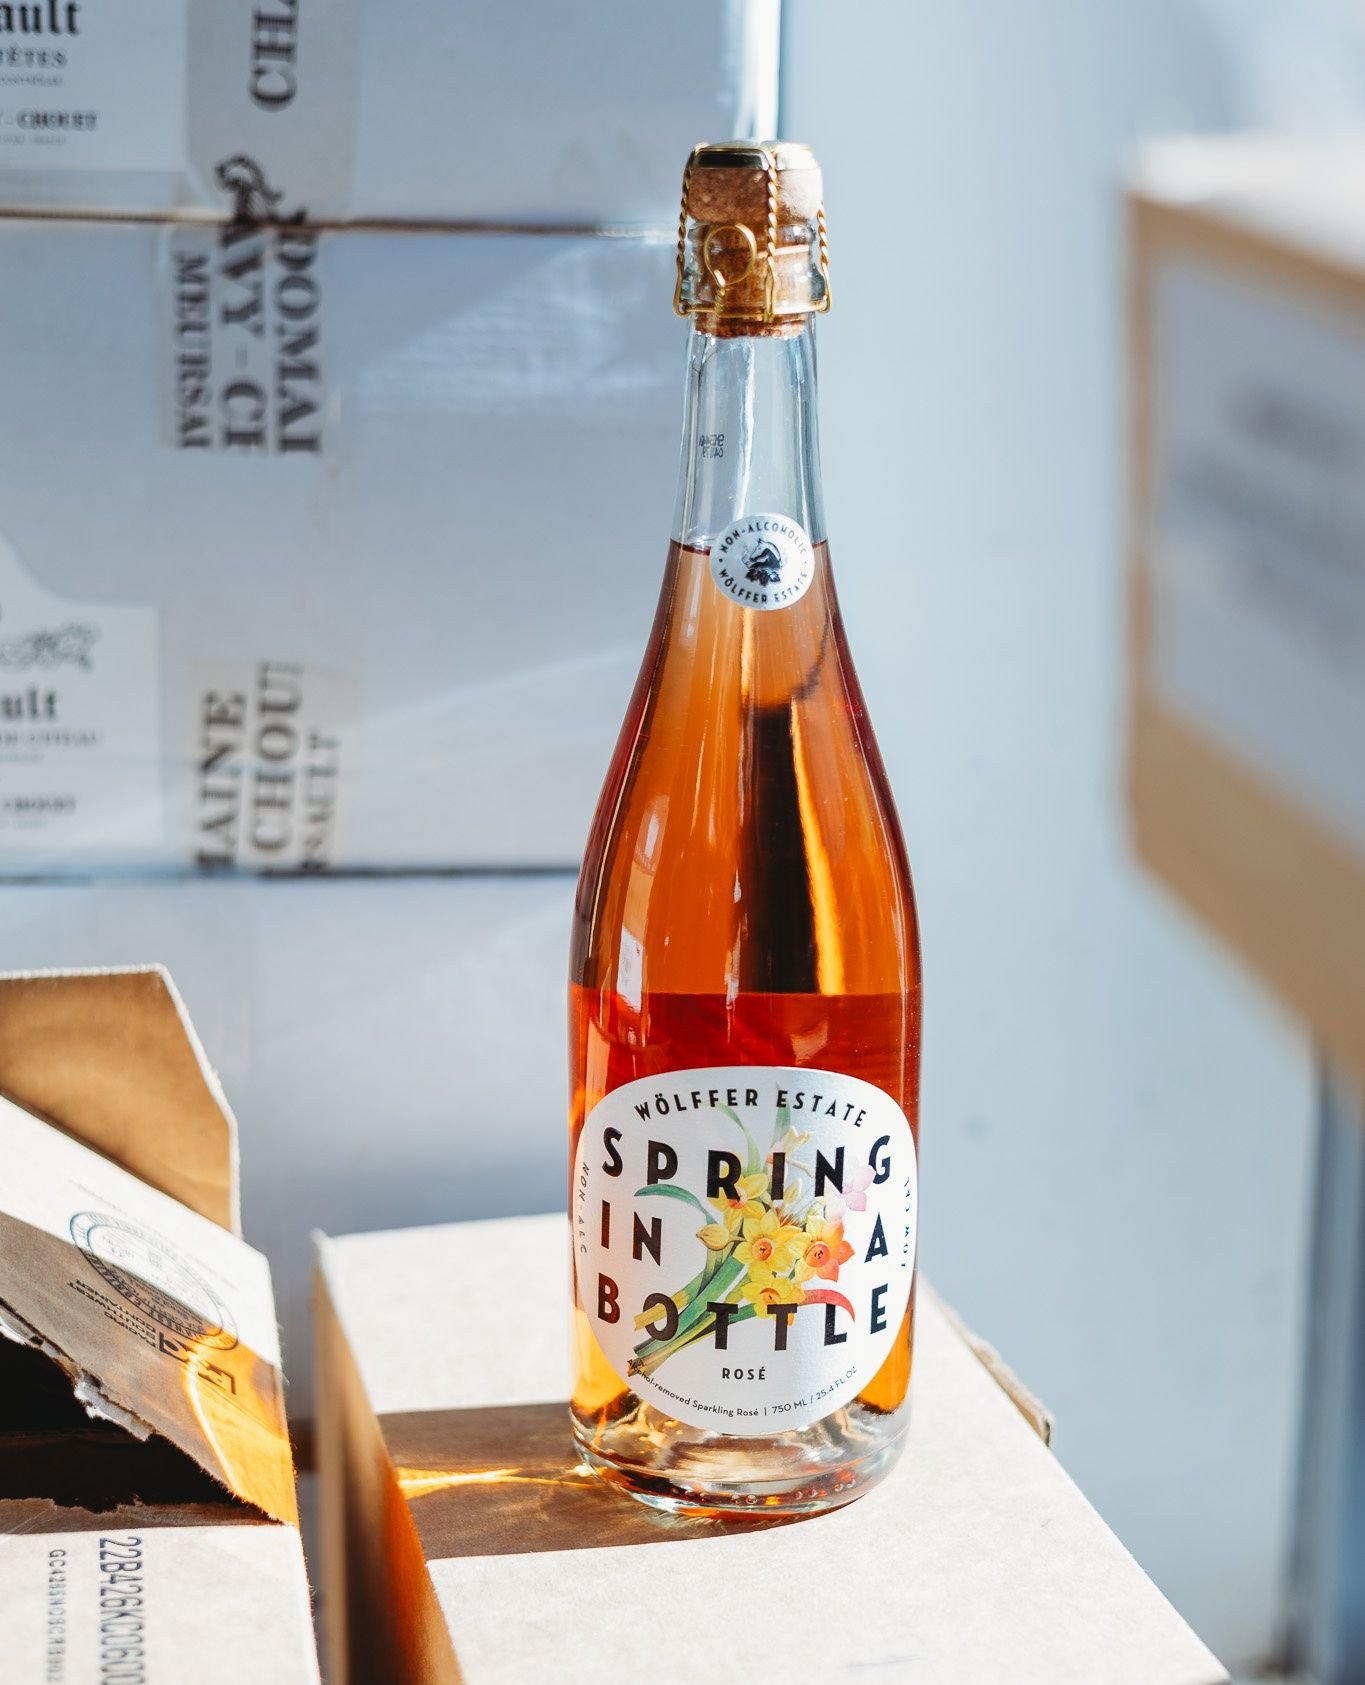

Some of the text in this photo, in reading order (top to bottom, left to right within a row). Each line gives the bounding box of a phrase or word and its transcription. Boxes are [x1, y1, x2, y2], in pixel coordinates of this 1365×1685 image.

[719, 568, 768, 604] WÖLFFER
[634, 1088, 867, 1127] WÖLFFER ESTATE
[602, 1127, 891, 1202] SPRING
[601, 1200, 889, 1266] IN A
[598, 1272, 889, 1351] BOTTLE
[722, 1366, 766, 1380] ROSÉ
[692, 1400, 734, 1417] Sparkling
[737, 1408, 759, 1417] Rosé
[772, 1403, 791, 1414] 750
[794, 1398, 808, 1409] ML
